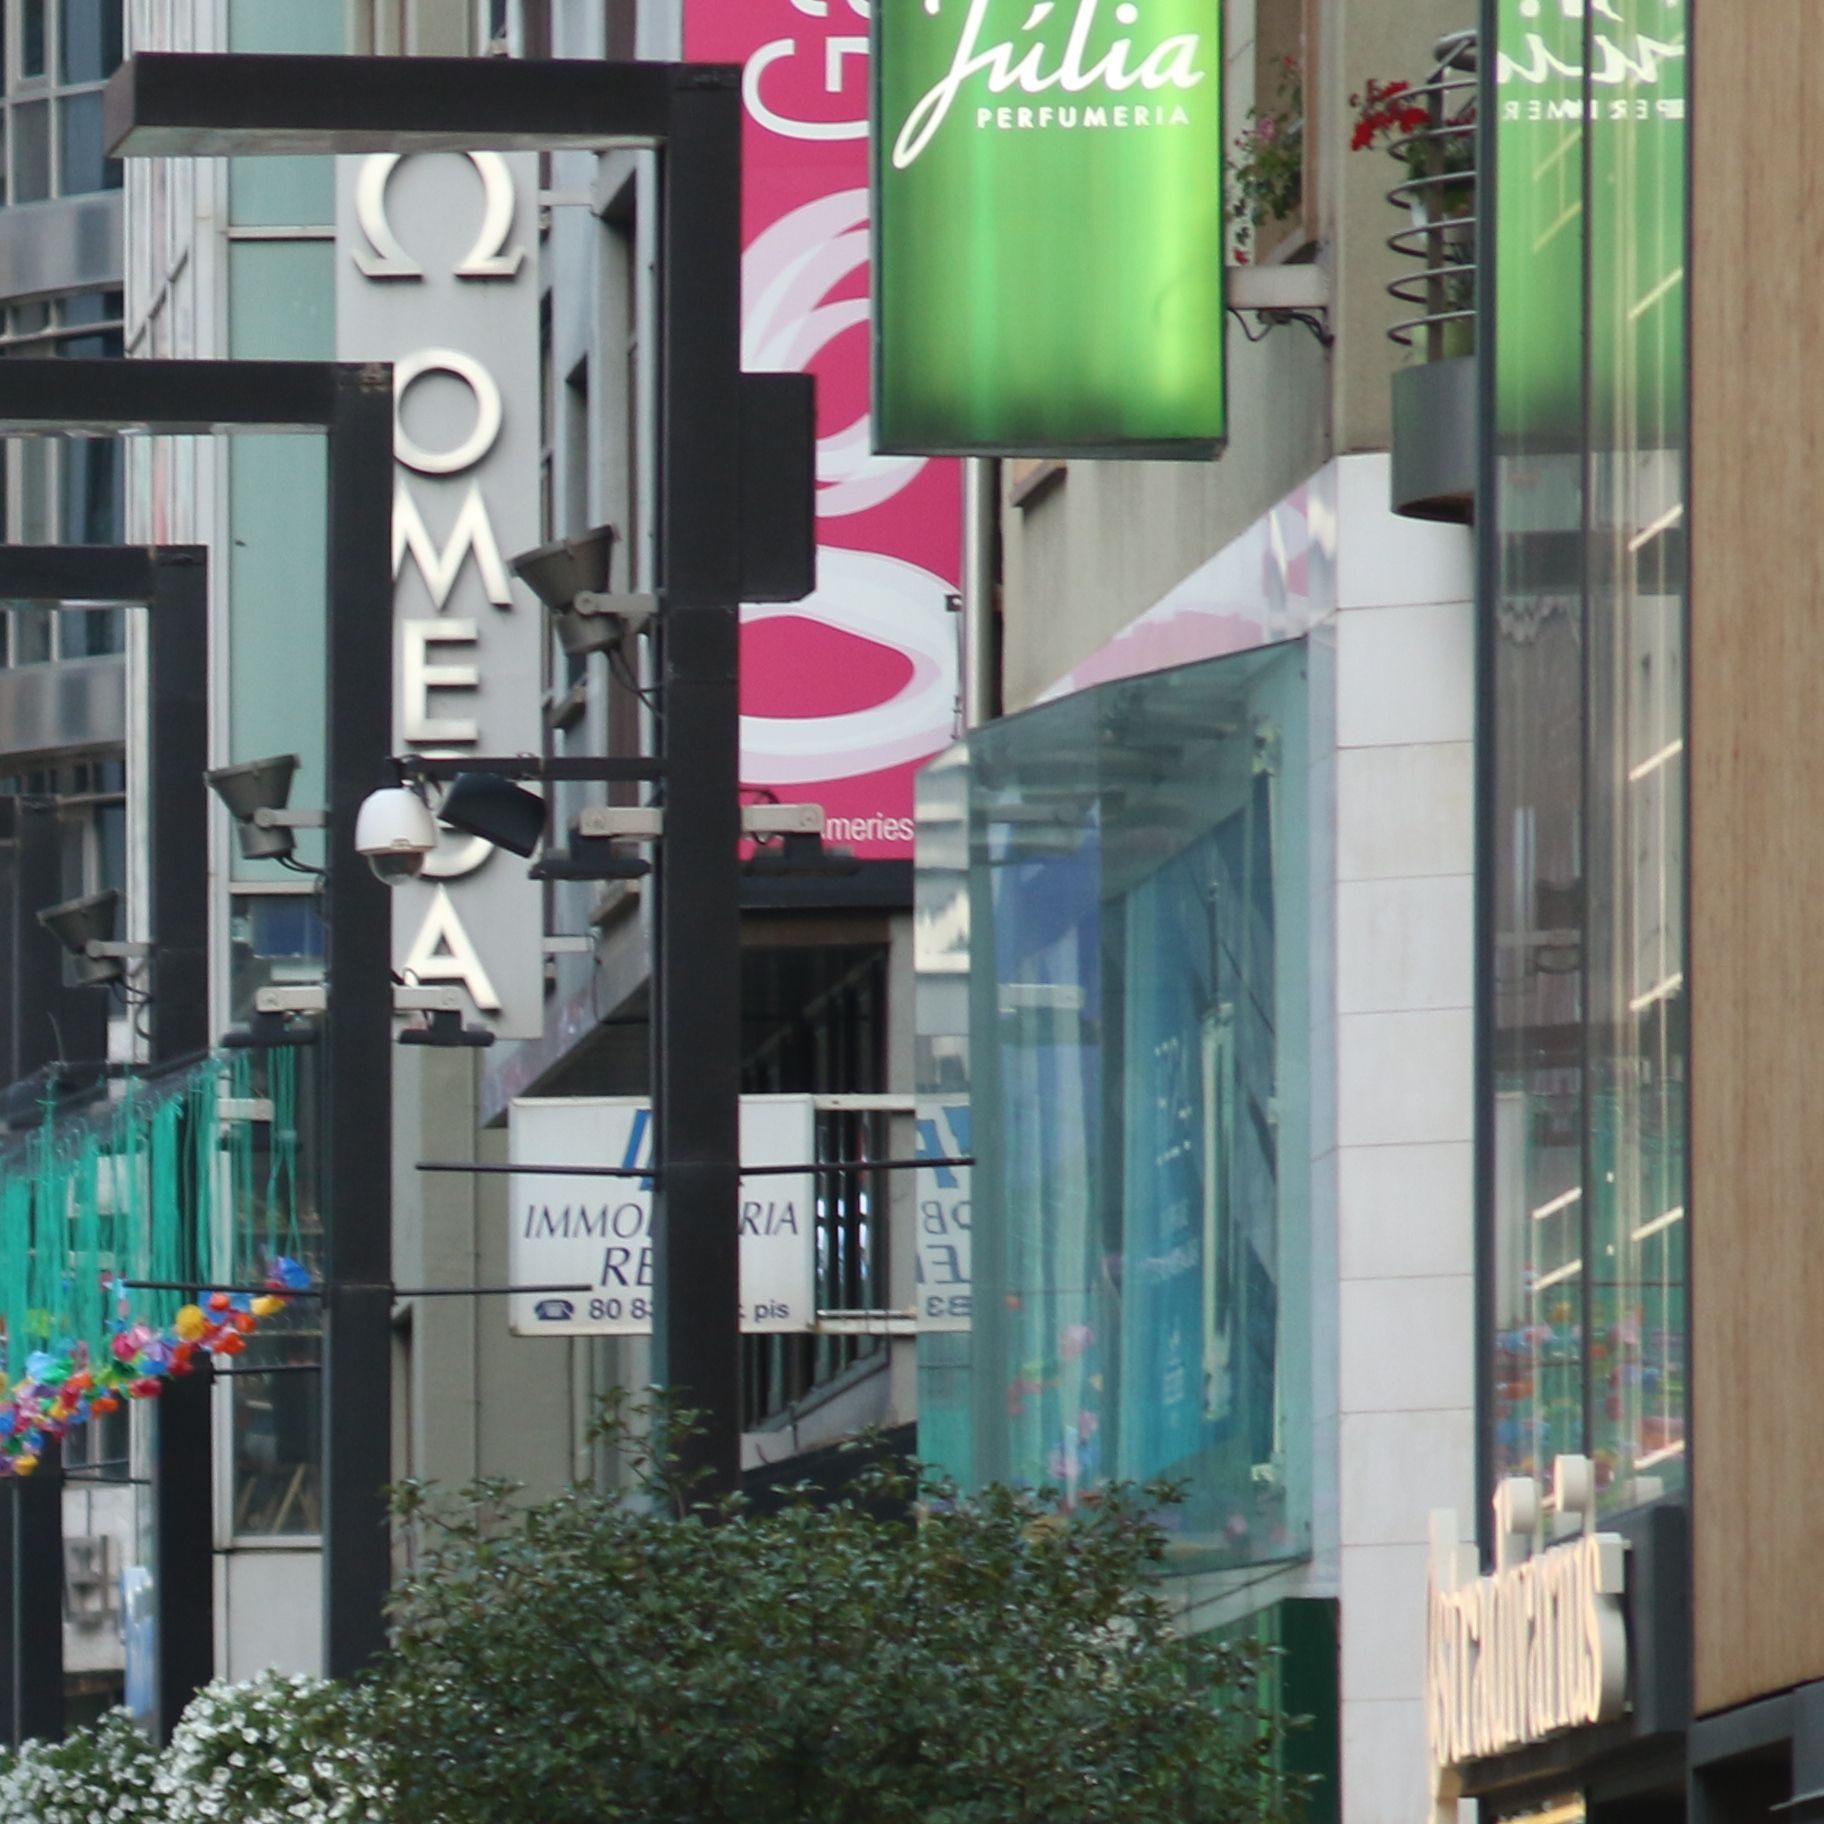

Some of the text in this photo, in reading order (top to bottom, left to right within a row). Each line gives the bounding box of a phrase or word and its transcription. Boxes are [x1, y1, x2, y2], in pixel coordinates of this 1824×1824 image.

[892, 0, 1205, 169] Júlia
[976, 105, 1190, 129] PERFUMERIA
[820, 811, 915, 841] meries
[522, 1199, 800, 1240] IMMORIA
